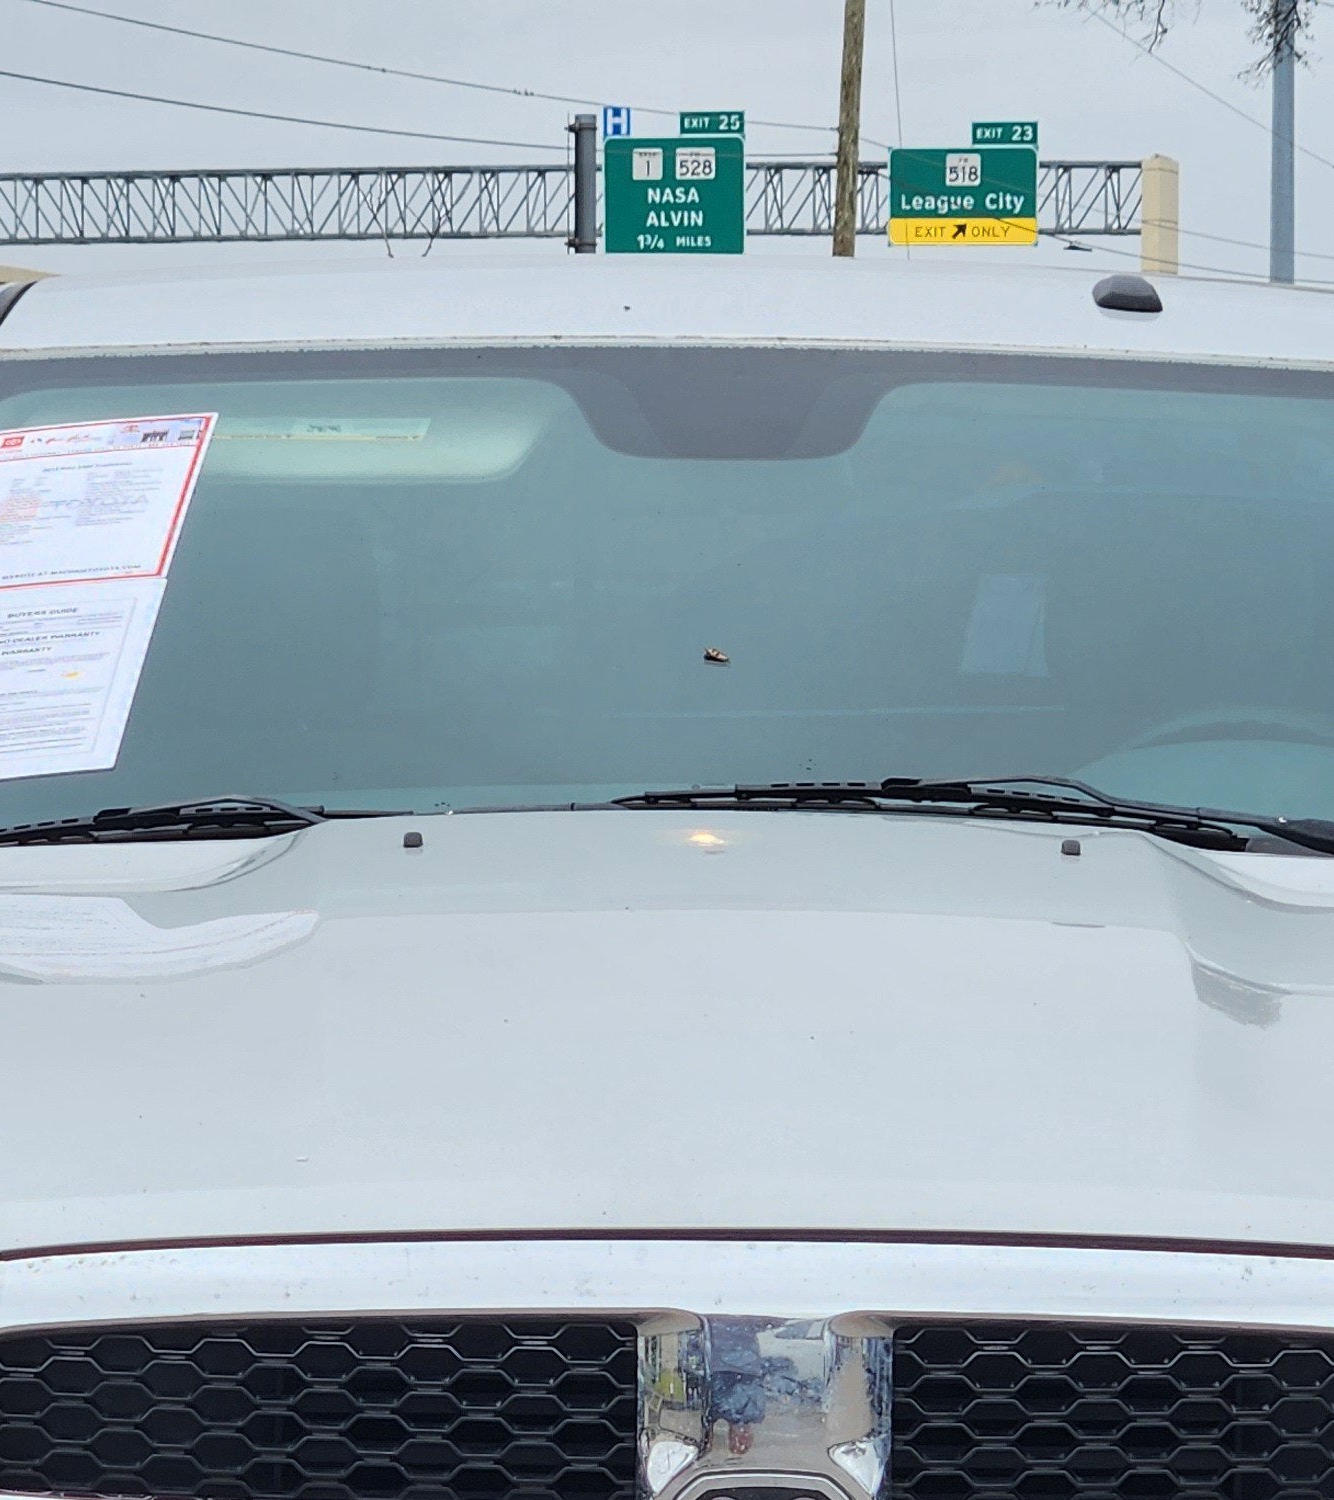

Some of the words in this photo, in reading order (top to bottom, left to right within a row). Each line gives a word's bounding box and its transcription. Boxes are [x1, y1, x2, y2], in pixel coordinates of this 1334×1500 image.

[684, 117, 709, 129] EXIT
[719, 115, 740, 130] 25
[976, 127, 1003, 139] EXIT
[1011, 125, 1033, 141] 23
[679, 160, 713, 176] 528
[948, 166, 979, 183] 518
[647, 187, 700, 204] NASA
[901, 193, 975, 214] League
[985, 192, 1025, 214] City
[646, 210, 704, 227] ALVIN
[915, 226, 946, 238] EXIT
[971, 226, 1011, 238] ONLY
[676, 235, 712, 248] MILES
